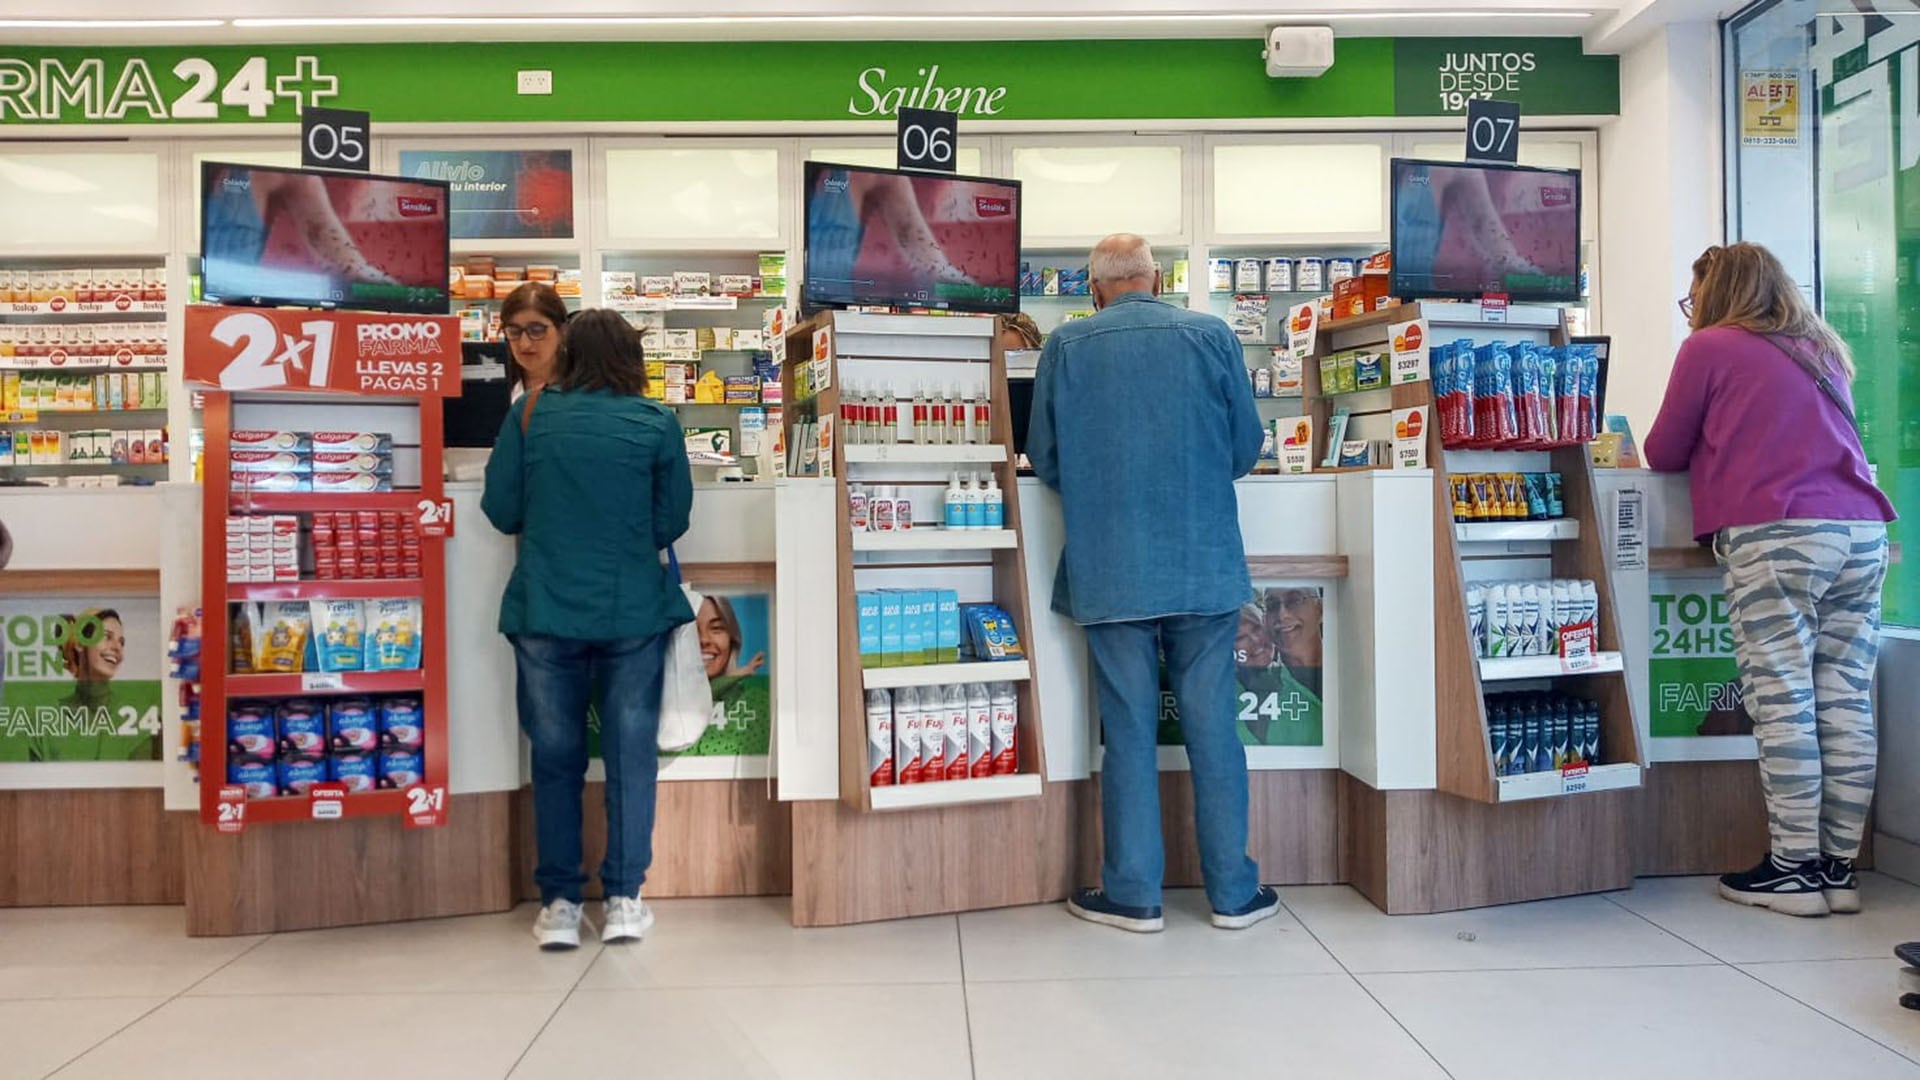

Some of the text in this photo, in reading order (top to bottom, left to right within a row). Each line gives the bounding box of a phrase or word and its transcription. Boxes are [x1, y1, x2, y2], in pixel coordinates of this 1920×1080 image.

[1439, 52, 1536, 72] JUNTOS
[849, 65, 1006, 115] Saibene
[1440, 72, 1520, 91] DESDE
[308, 123, 364, 161] 05
[903, 125, 952, 162] 06
[1472, 117, 1515, 153] 07
[415, 160, 485, 182] Alivio
[450, 182, 507, 192] tu interior
[357, 321, 441, 341] PROMO
[210, 313, 335, 390] 2x1
[358, 338, 443, 357] FARMA
[356, 360, 443, 376] LLEVAS 2
[361, 375, 439, 391] PAGAS 1
[232, 432, 270, 441] Colgate
[315, 433, 350, 441] Colgate
[232, 452, 270, 461] Colgate
[315, 453, 350, 461] Colgate
[417, 500, 451, 524] 2x1
[0, 614, 105, 647] ODO
[1561, 627, 1592, 641] OFERTA
[406, 787, 444, 814] 2x1
[217, 802, 244, 821] 2x1
